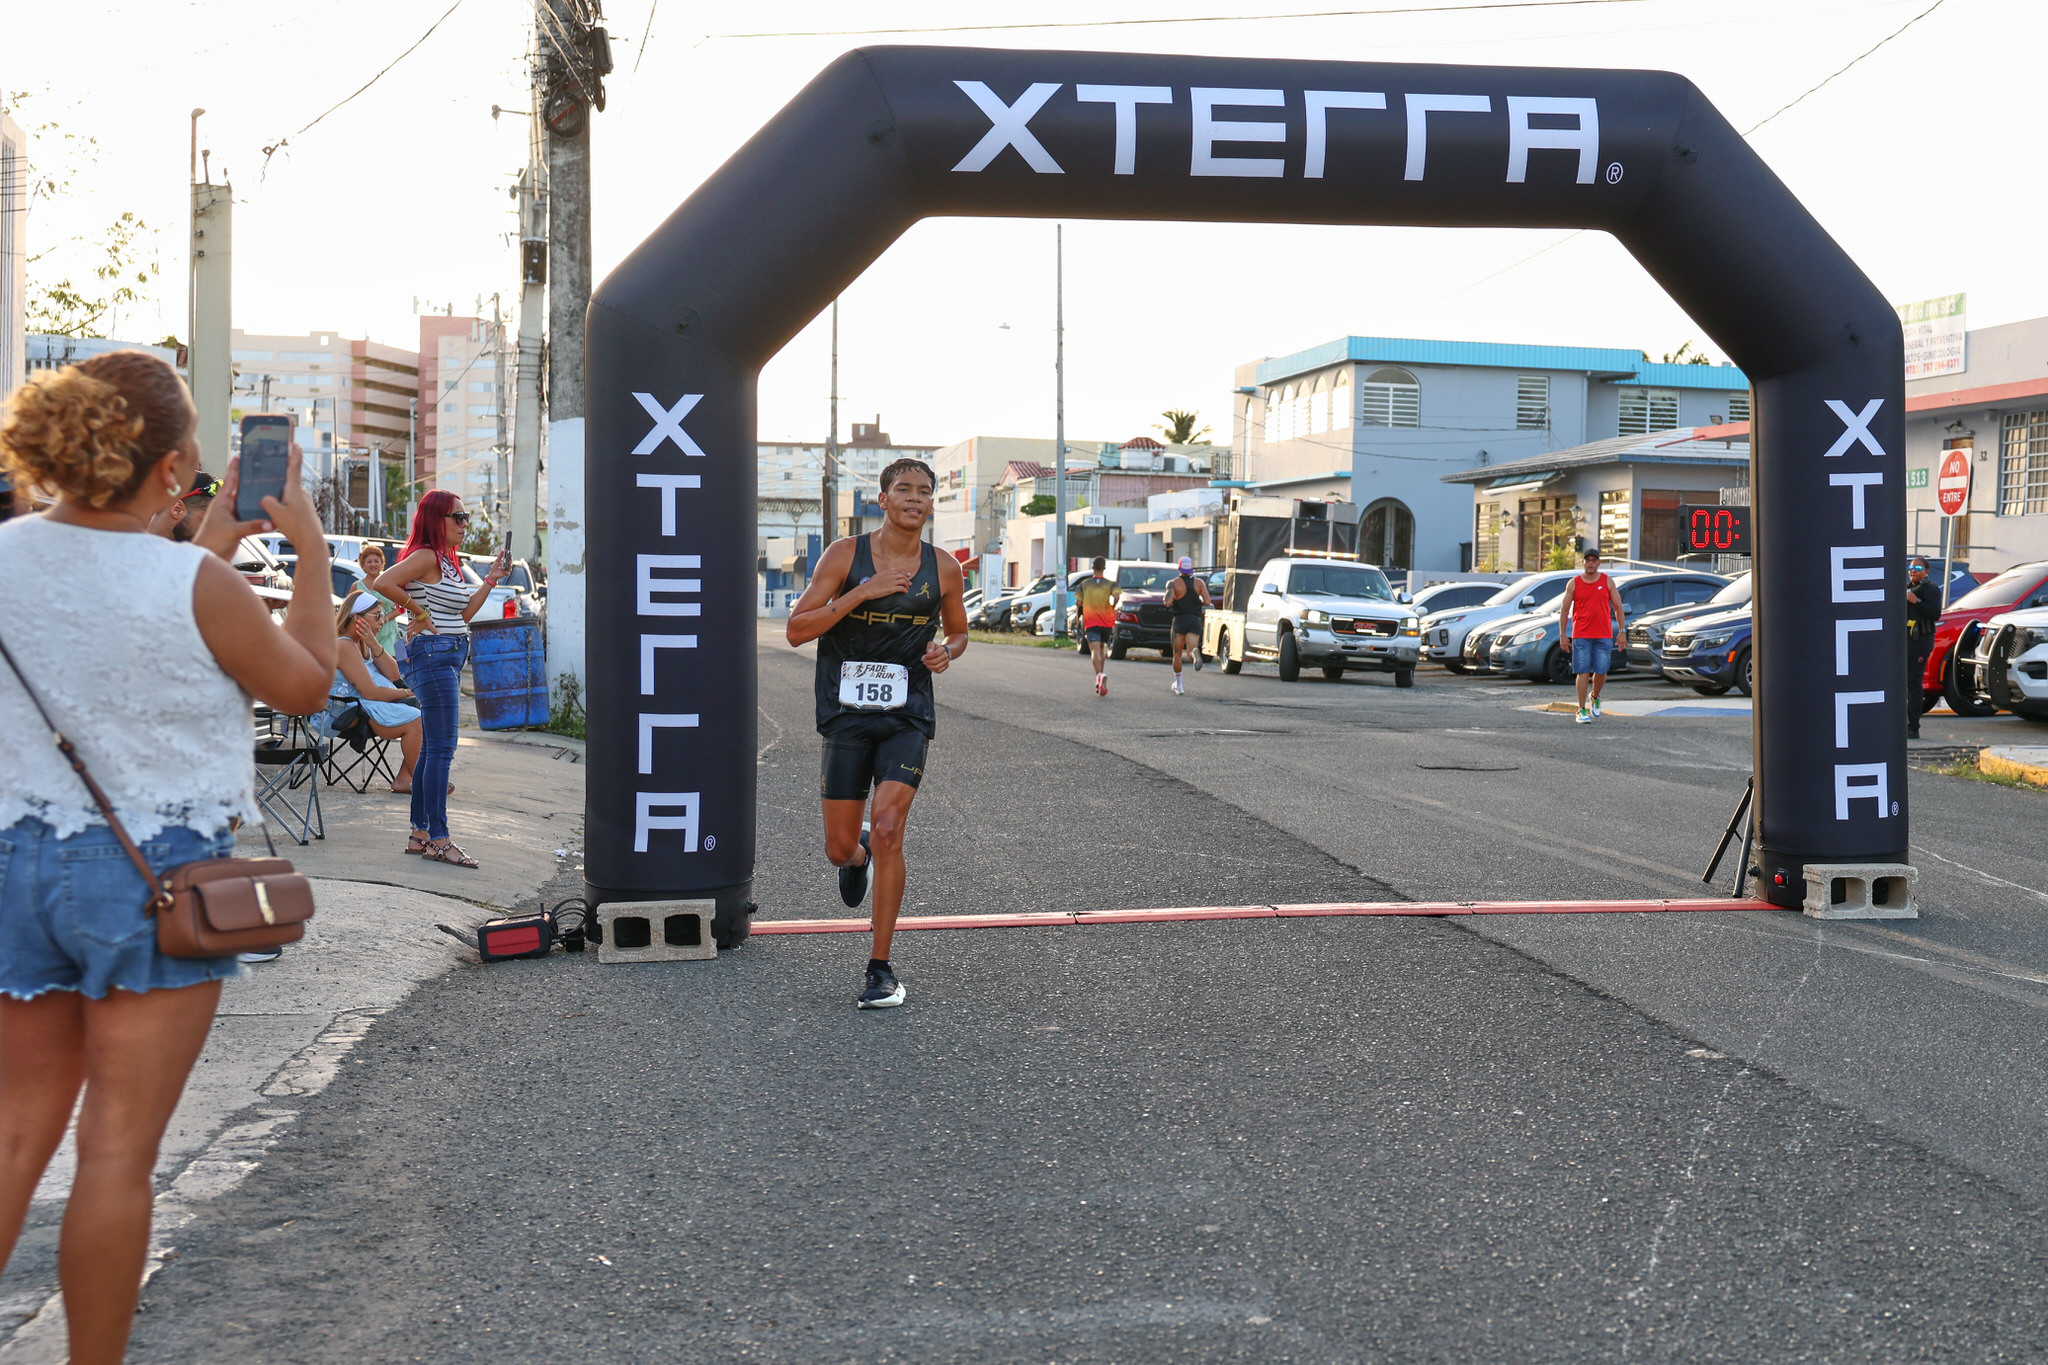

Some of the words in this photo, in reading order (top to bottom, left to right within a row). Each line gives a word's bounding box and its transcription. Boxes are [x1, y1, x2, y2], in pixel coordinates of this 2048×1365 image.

[1904, 337, 1925, 350] ENERAL
[1979, 450, 1988, 462] 32
[1949, 461, 1961, 474] NO
[1910, 470, 1927, 486] 513
[1943, 491, 1962, 503] ENTRE
[865, 664, 888, 673] FADE
[855, 682, 893, 703] 158
